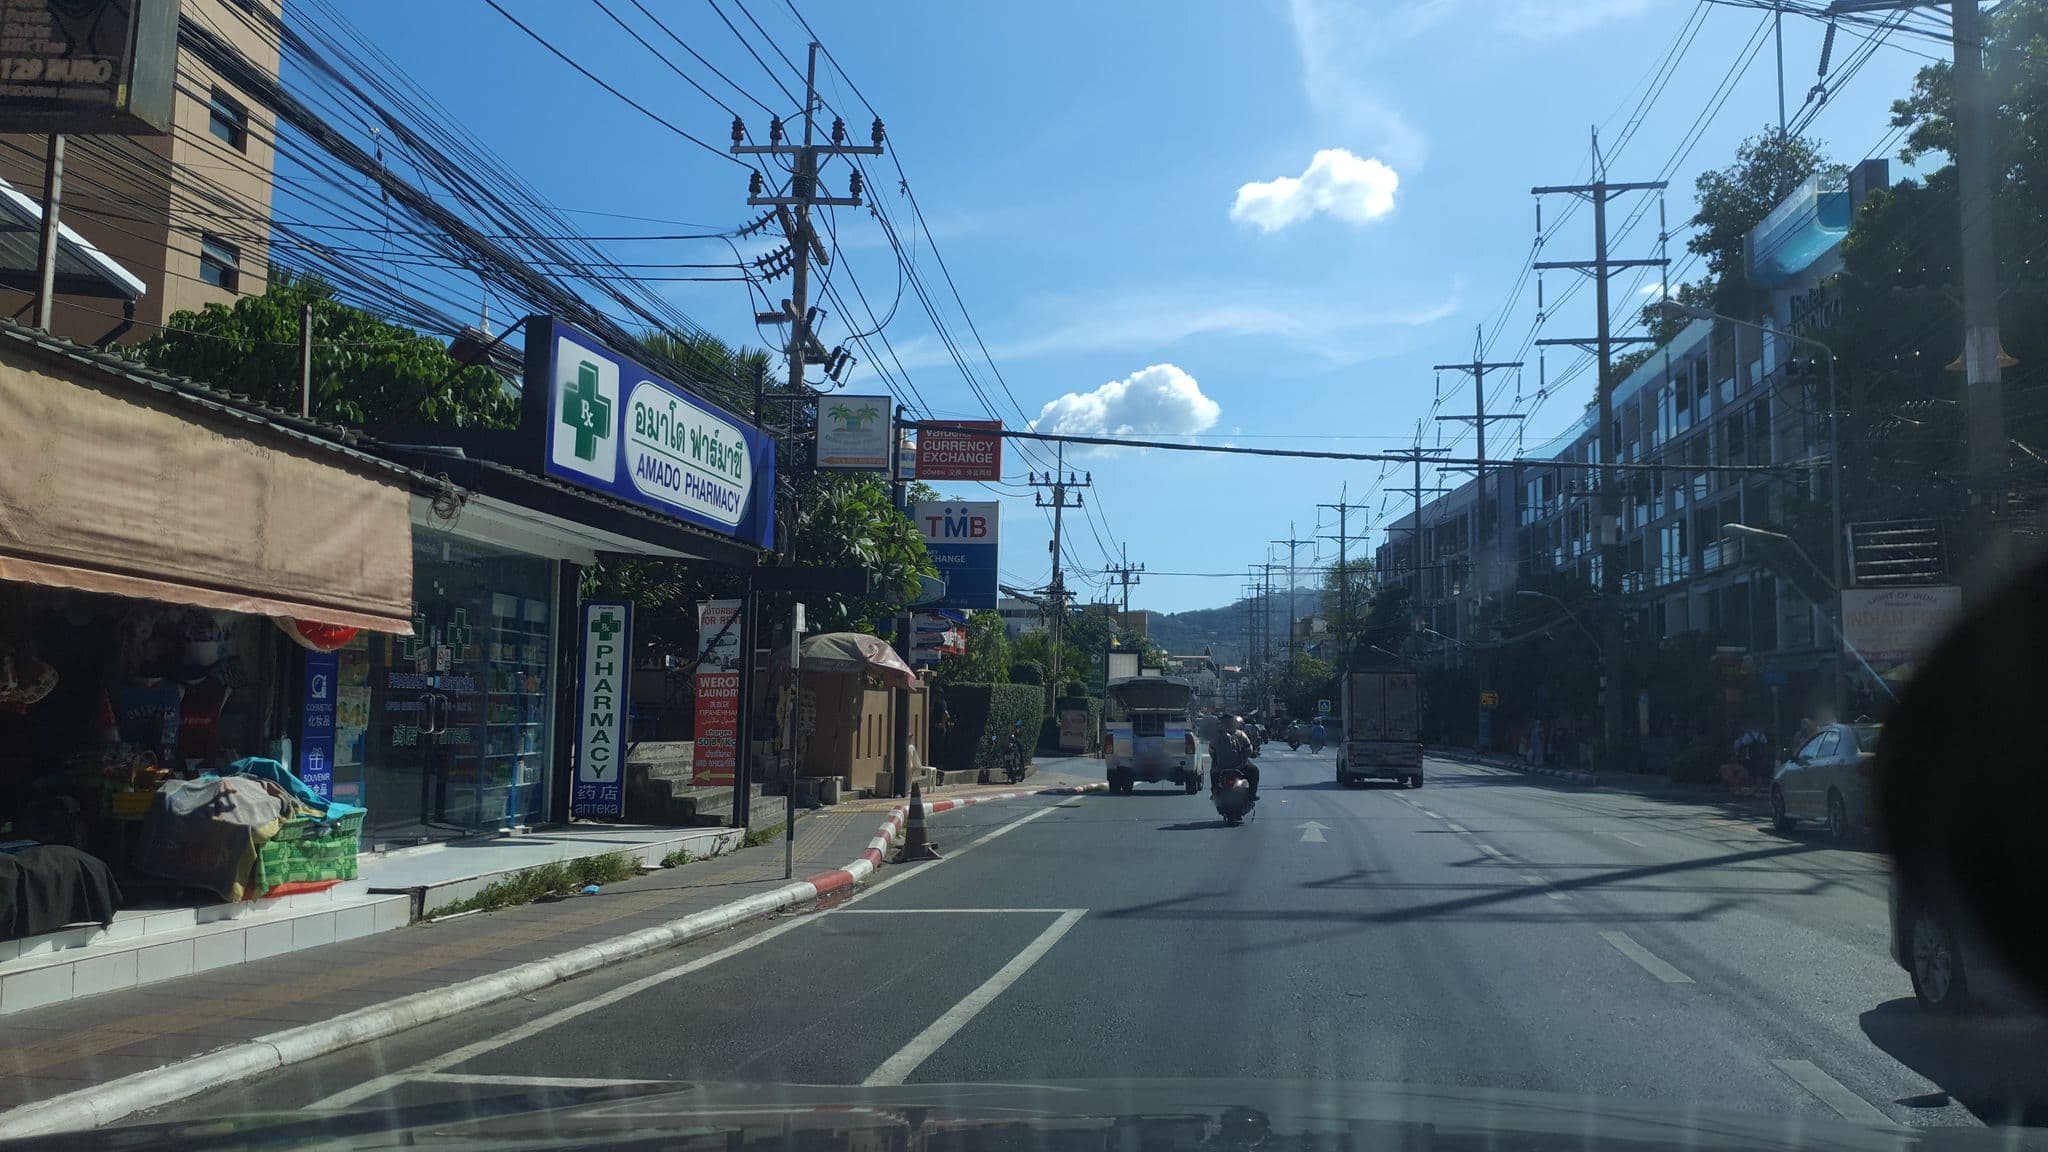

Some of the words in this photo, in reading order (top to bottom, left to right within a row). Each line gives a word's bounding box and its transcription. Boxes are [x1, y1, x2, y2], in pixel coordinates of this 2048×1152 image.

[634, 399, 686, 455] อมาโด
[922, 440, 994, 452] CURRENCY
[922, 452, 993, 464] EXCHANGE
[636, 453, 682, 492] AMADO
[685, 474, 741, 515] PHARMACY
[925, 516, 987, 538] TMB
[590, 645, 614, 780] PHARMACY
[303, 773, 331, 783] SOUVENIR
[577, 785, 619, 801] 药店
[575, 802, 619, 815] аптека
